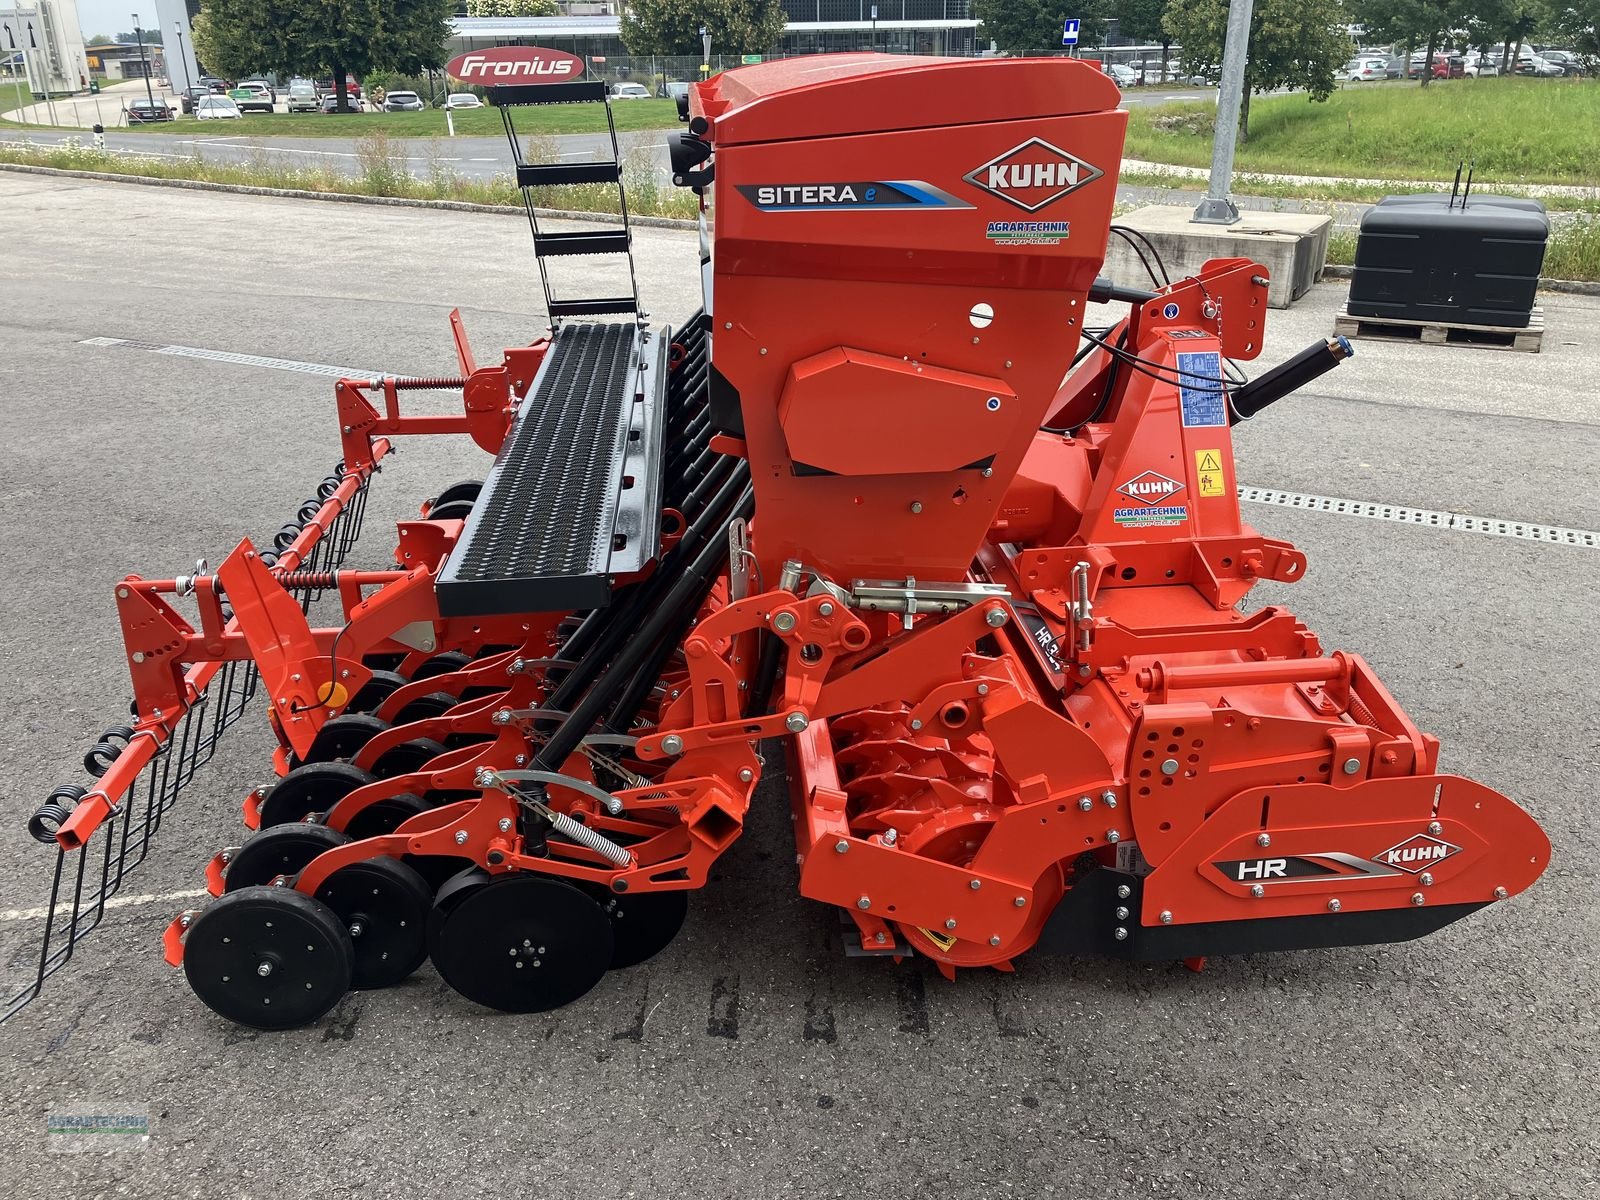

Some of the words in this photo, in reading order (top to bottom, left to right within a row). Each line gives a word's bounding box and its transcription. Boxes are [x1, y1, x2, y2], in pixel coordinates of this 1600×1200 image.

[460, 56, 573, 76] Fronius
[988, 163, 1078, 188] KUHN
[757, 185, 858, 204] SITERA
[864, 187, 876, 201] e
[987, 222, 1069, 232] AGRARTECHNIK
[1128, 481, 1174, 495] KUHN
[1114, 507, 1187, 517] AGRARTECHNIK
[1035, 626, 1052, 647] HR
[1387, 845, 1447, 864] KUHN
[1237, 859, 1287, 880] HR
